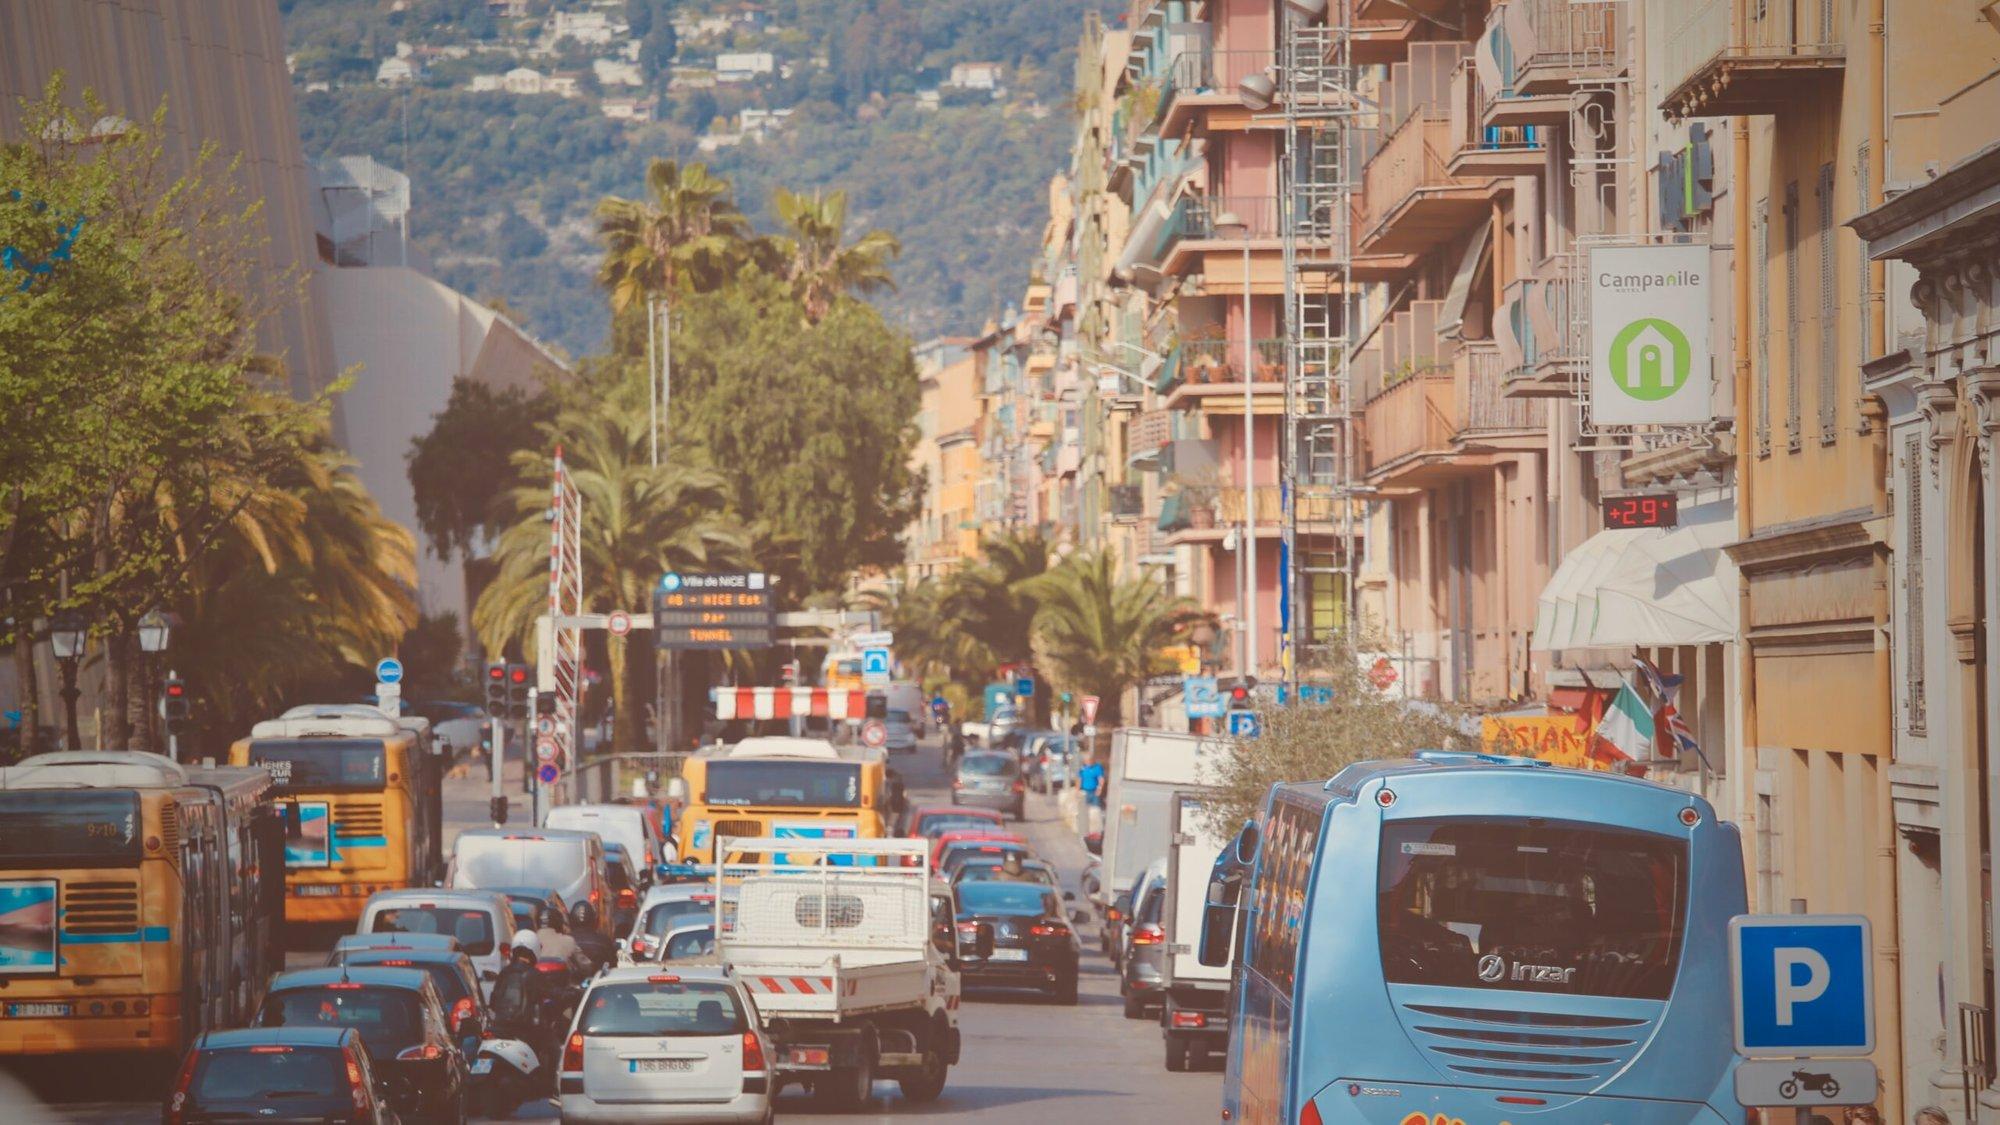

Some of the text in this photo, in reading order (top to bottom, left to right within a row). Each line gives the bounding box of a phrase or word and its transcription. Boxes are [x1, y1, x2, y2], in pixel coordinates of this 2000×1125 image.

[1599, 270, 1700, 292] Campanile
[681, 575, 746, 587] Ville de NICE
[702, 593, 733, 606] NICE
[738, 593, 761, 606] Est
[690, 628, 733, 641] TUNNEL
[1496, 726, 1584, 753] ASIAN
[1511, 961, 1577, 984] Irizar
[1773, 946, 1831, 1026] P
